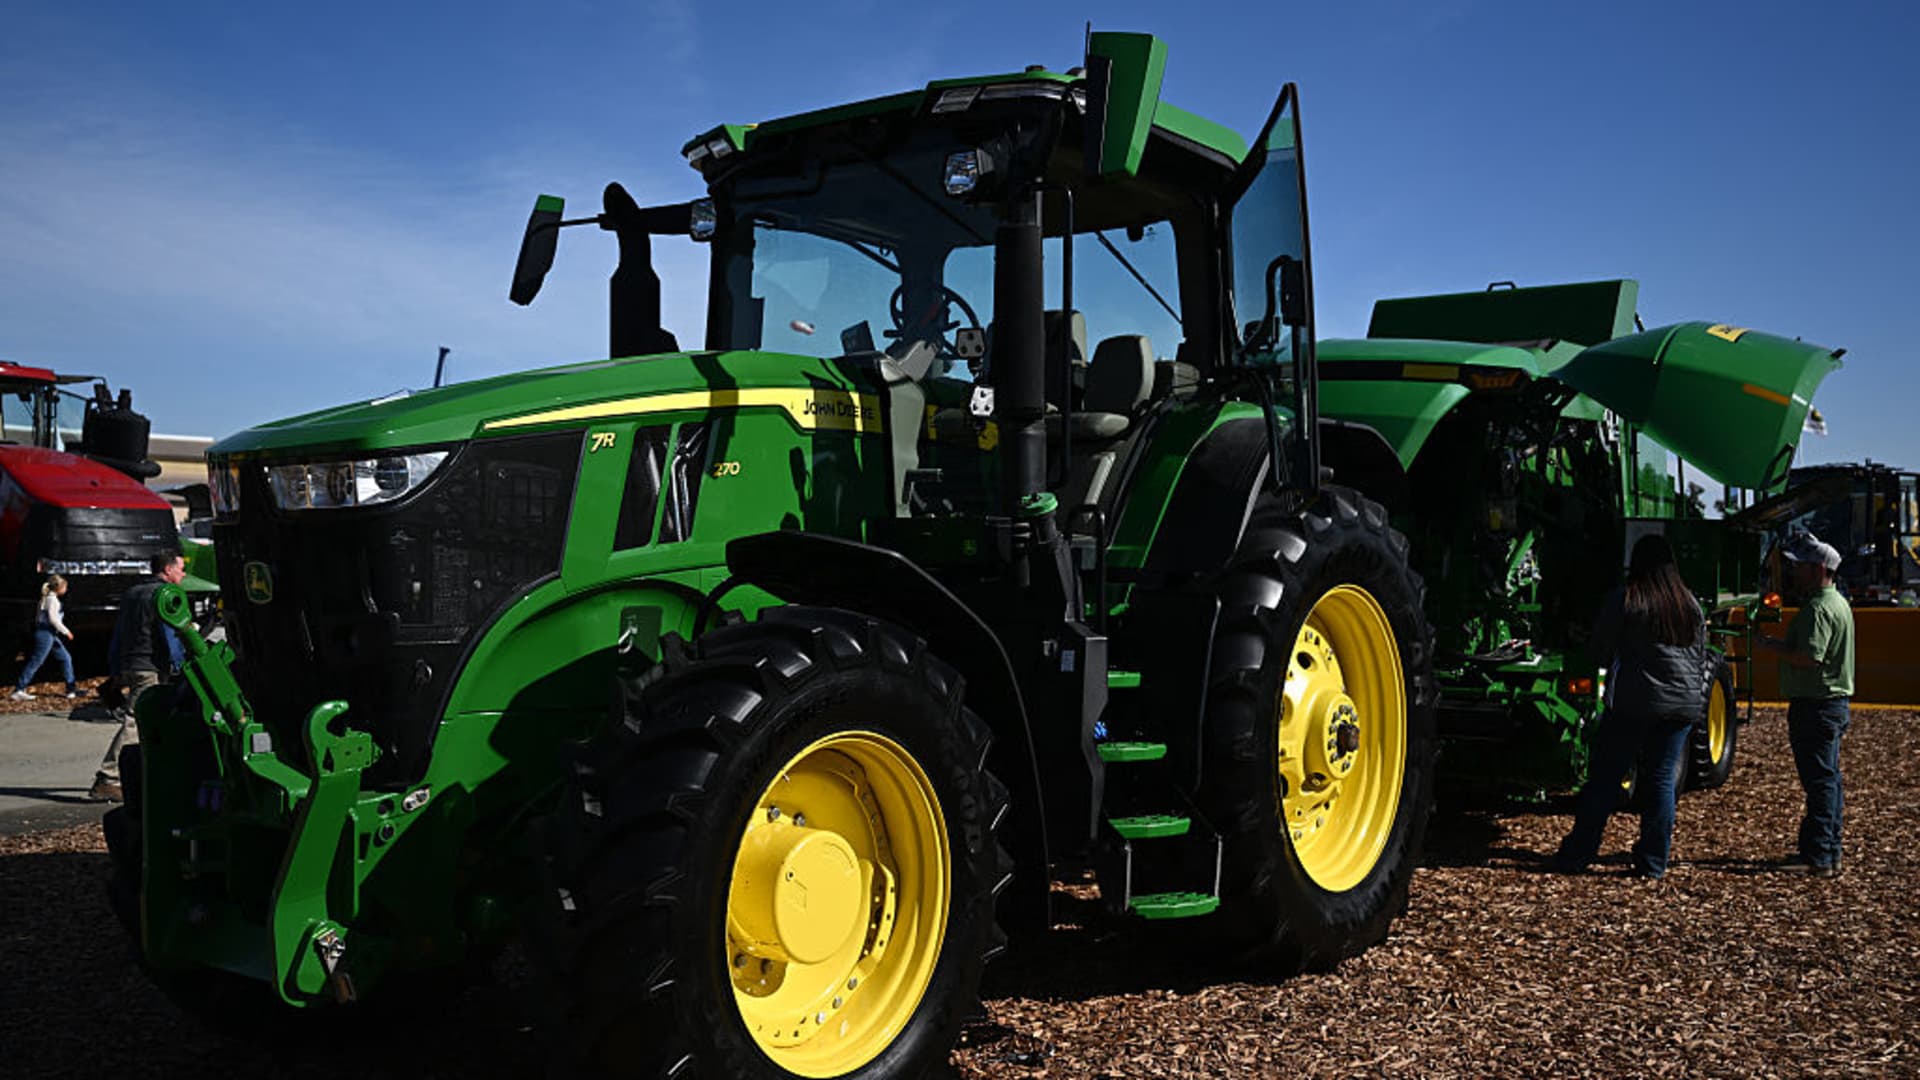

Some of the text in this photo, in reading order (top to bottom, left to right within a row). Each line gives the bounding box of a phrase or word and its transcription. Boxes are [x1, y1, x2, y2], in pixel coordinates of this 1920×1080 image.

[803, 399, 874, 420] JOHN DEERE
[590, 432, 616, 453] 7R
[712, 461, 741, 478] 270
